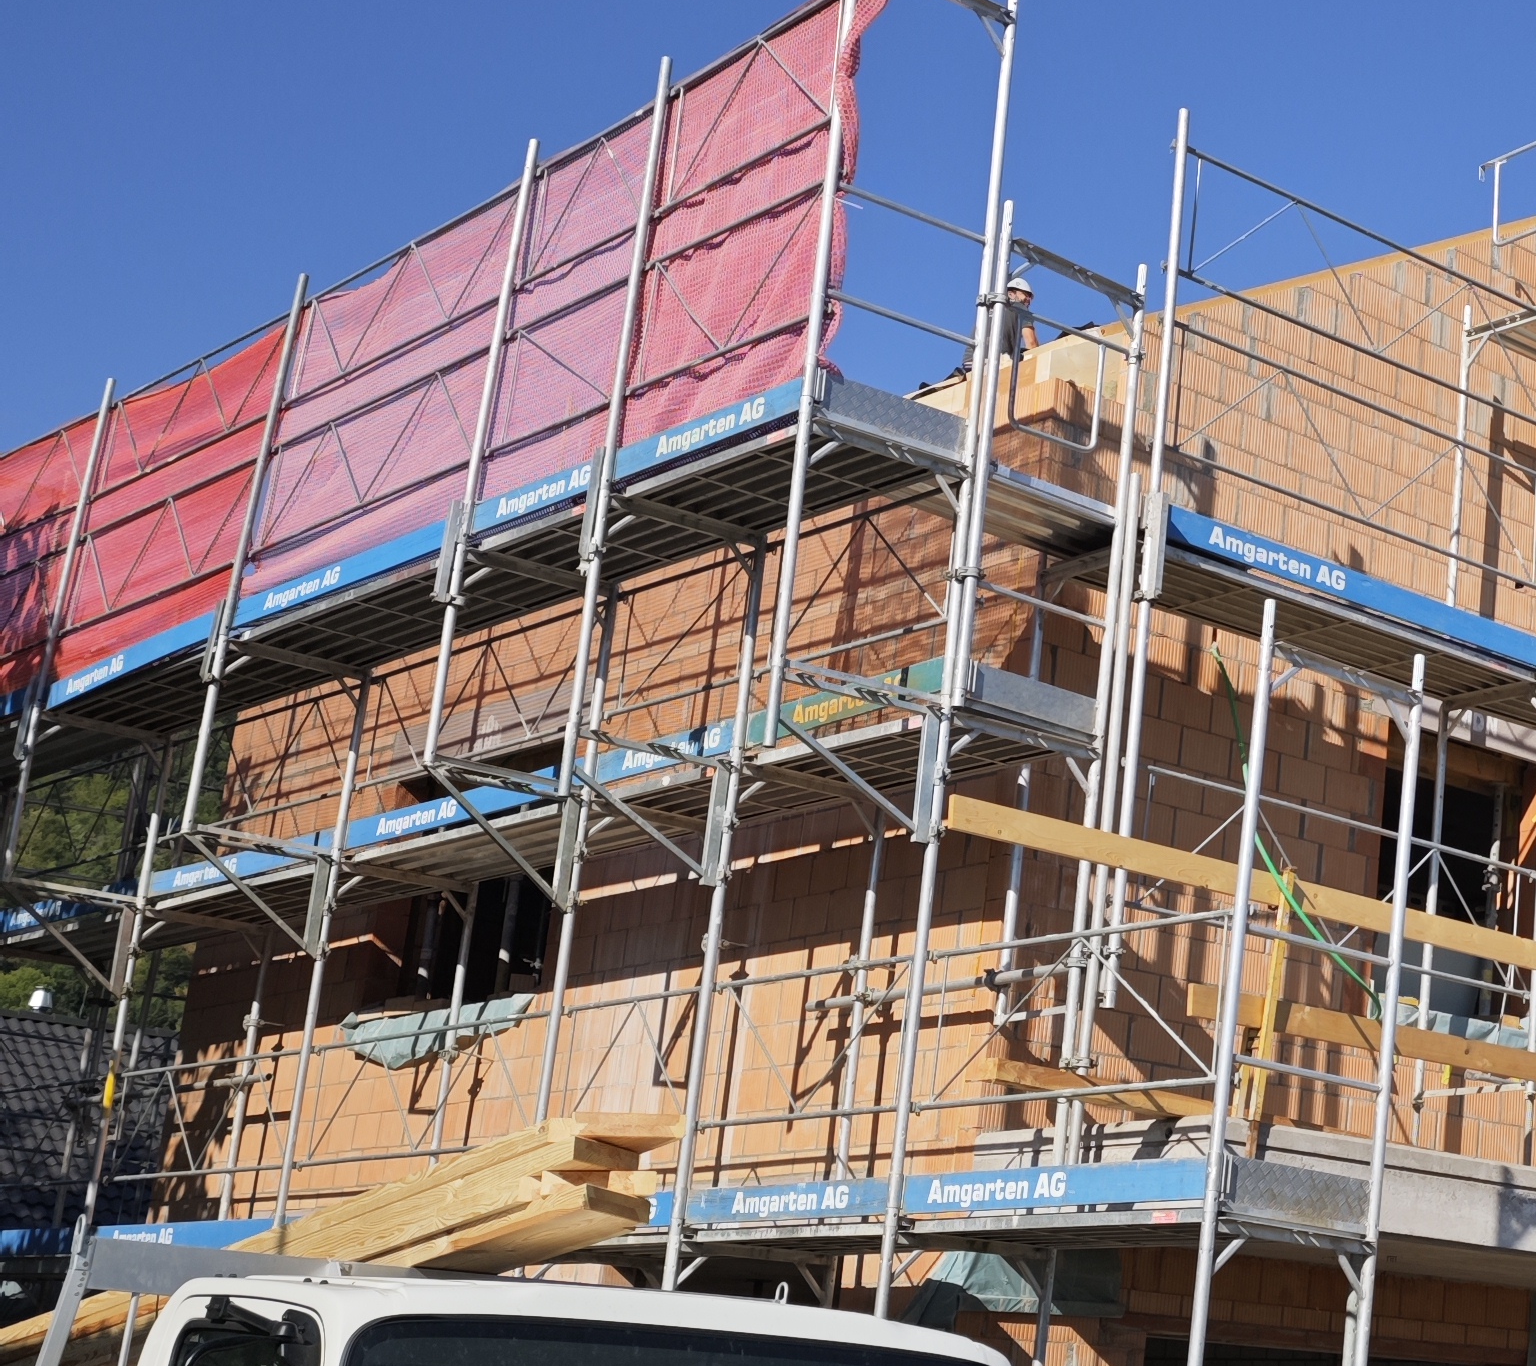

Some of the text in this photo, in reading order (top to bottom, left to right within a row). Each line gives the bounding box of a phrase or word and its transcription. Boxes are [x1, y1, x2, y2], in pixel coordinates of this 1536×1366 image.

[655, 396, 766, 458] Amgarten AG
[495, 465, 591, 519] Amgarten AG
[1208, 525, 1346, 591] Amgarten AG
[262, 566, 341, 610] Amgarten AG
[66, 654, 124, 695] Amgarten AG
[375, 799, 458, 837] Amgarten AG
[731, 1185, 849, 1218] Amgarten AG
[927, 1171, 1067, 1208] Amgarten AG
[158, 1228, 174, 1245] AG
